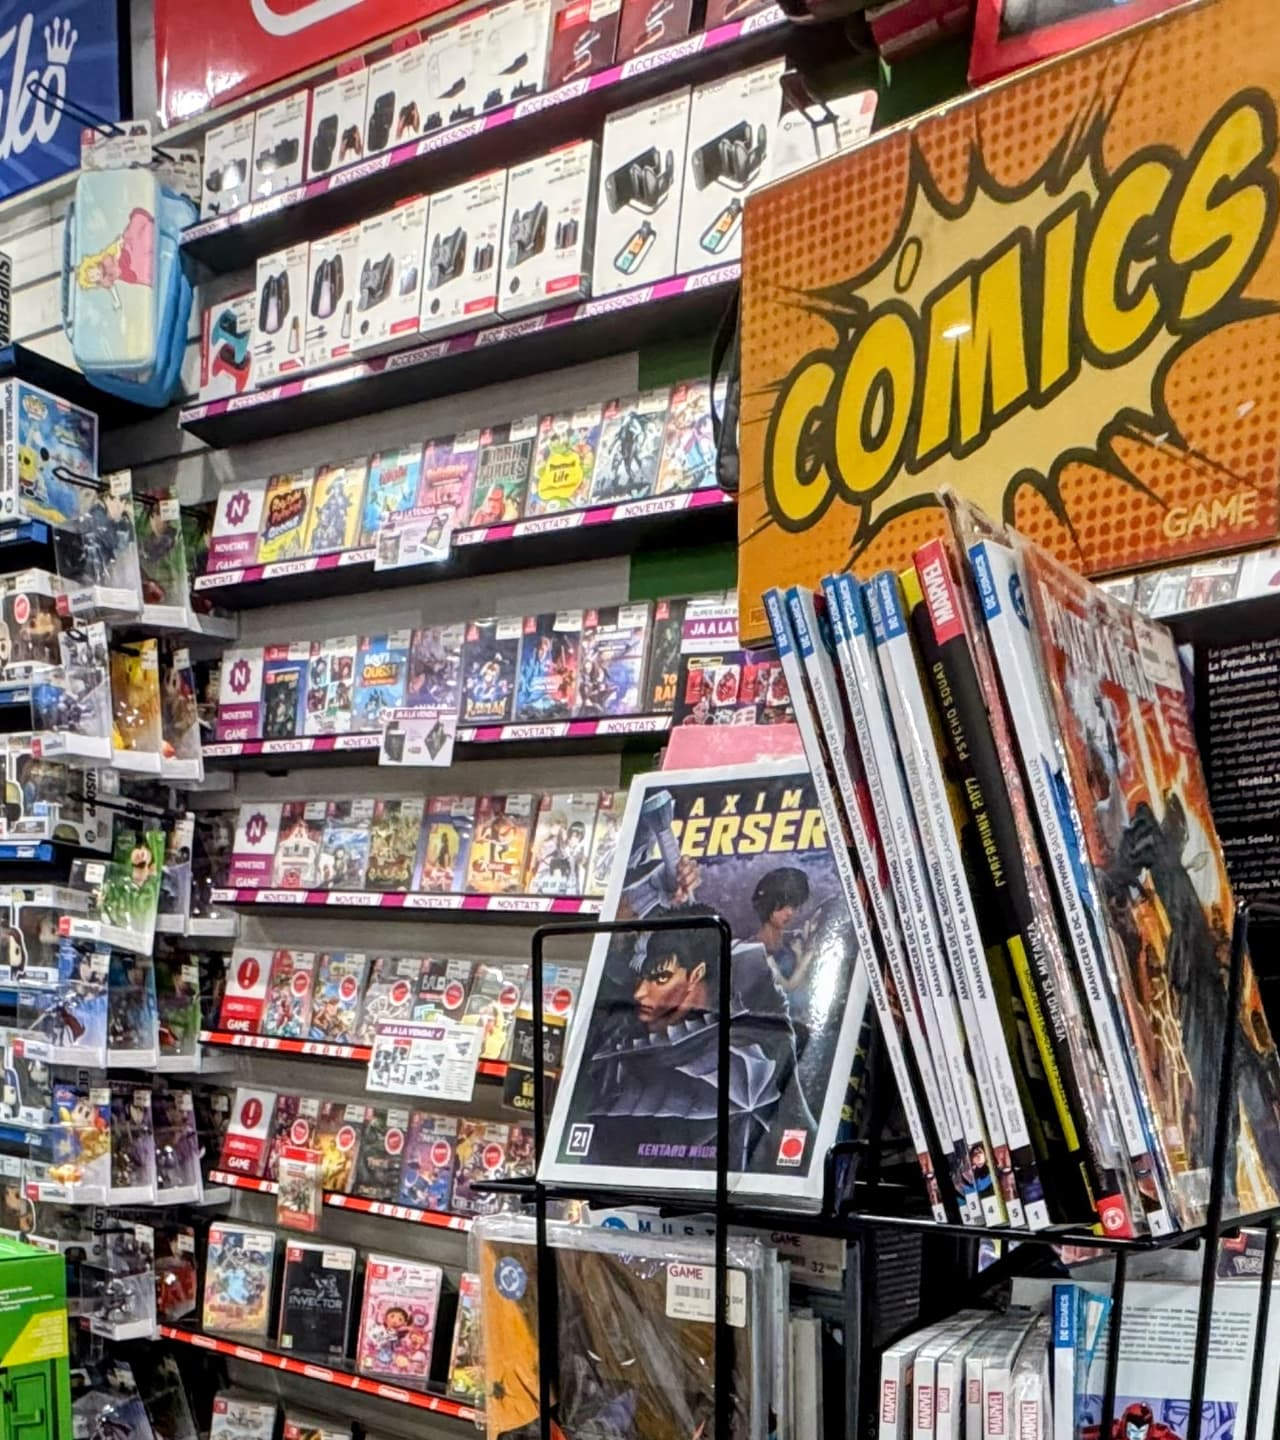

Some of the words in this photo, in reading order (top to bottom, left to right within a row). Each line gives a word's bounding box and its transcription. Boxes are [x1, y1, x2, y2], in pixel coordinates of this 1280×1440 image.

[767, 93, 1277, 528] COMICS
[624, 499, 675, 516] NOVETATS
[1163, 489, 1256, 540] GAME
[524, 518, 570, 533] NOVETATS
[922, 558, 955, 626] MARVEL
[690, 624, 705, 635] JA
[932, 661, 953, 702] SQUAD
[224, 729, 248, 740] GAME
[511, 726, 555, 736] NOVETATS
[607, 720, 656, 732] NOVETATS
[945, 701, 969, 761] PSYCHO
[236, 875, 259, 887] GAME
[948, 873, 966, 914] BATMAN
[227, 1019, 250, 1031] GAME
[571, 1132, 588, 1149] 21
[637, 1143, 681, 1160] KENTARO
[228, 1157, 250, 1170] GAME
[771, 1231, 801, 1247] GAME
[669, 1263, 704, 1281] GAME
[883, 1379, 897, 1424] MARVEL
[920, 1386, 932, 1429] MARVEL
[988, 1392, 1004, 1435] MARVEL
